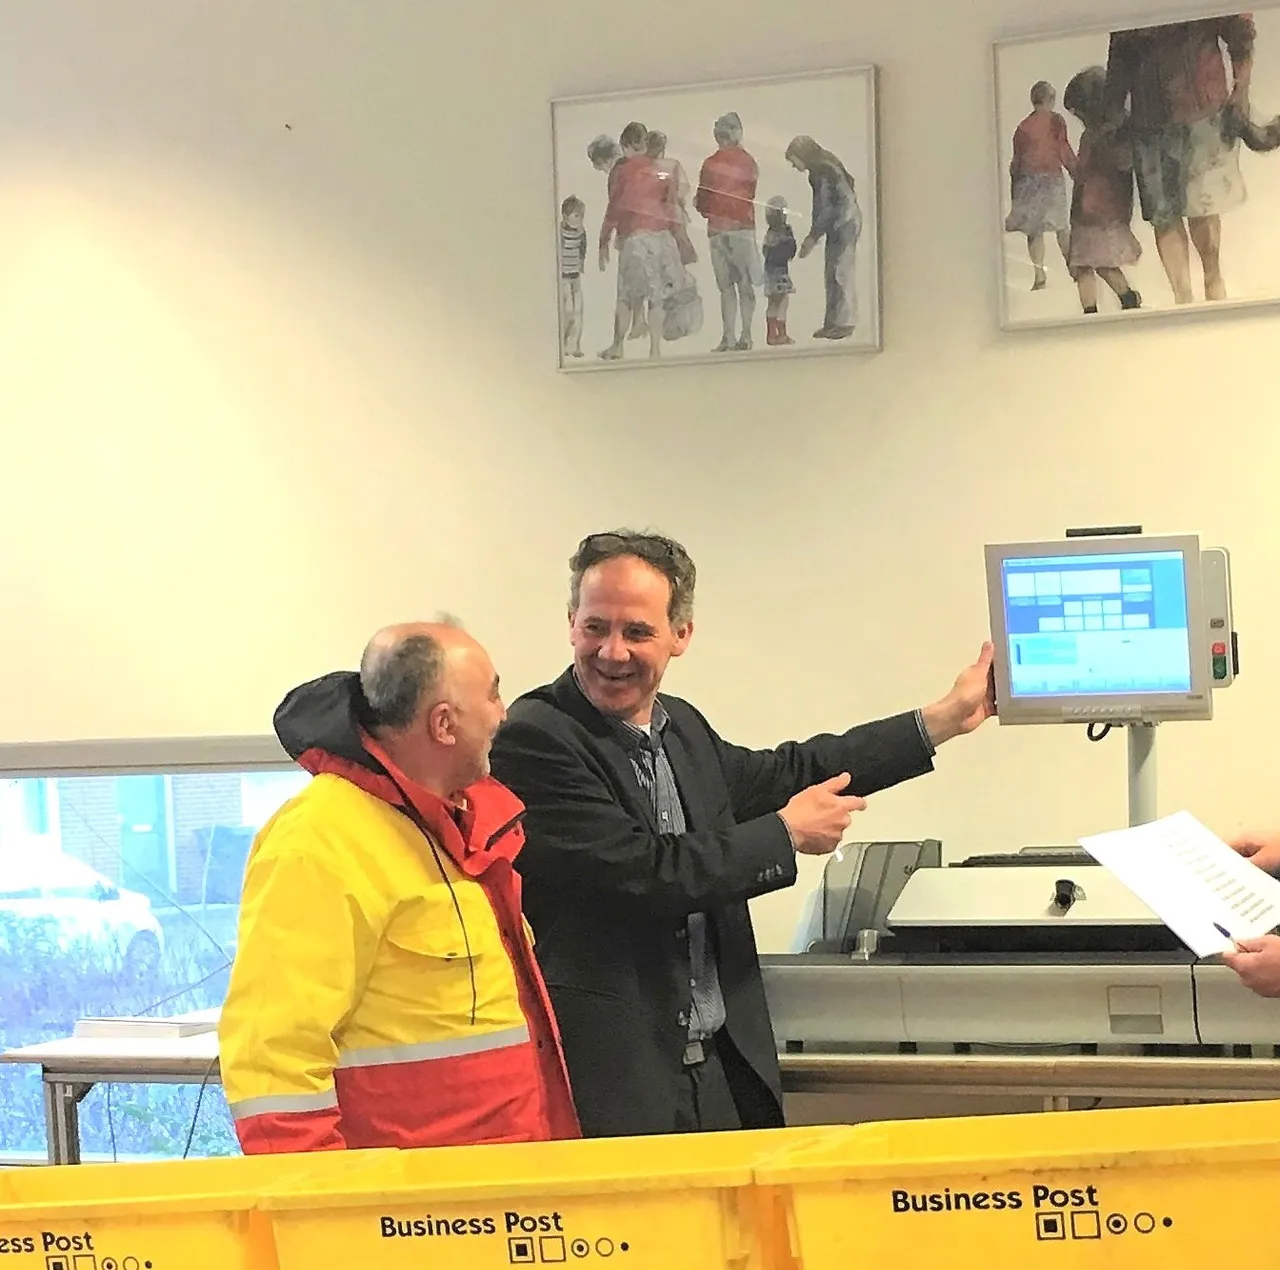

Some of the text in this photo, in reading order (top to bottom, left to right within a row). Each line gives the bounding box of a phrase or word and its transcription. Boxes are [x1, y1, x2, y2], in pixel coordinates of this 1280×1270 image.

[891, 1184, 1099, 1213] Business Post
[380, 1211, 564, 1238] Business Post
[41, 1231, 94, 1252] Post
